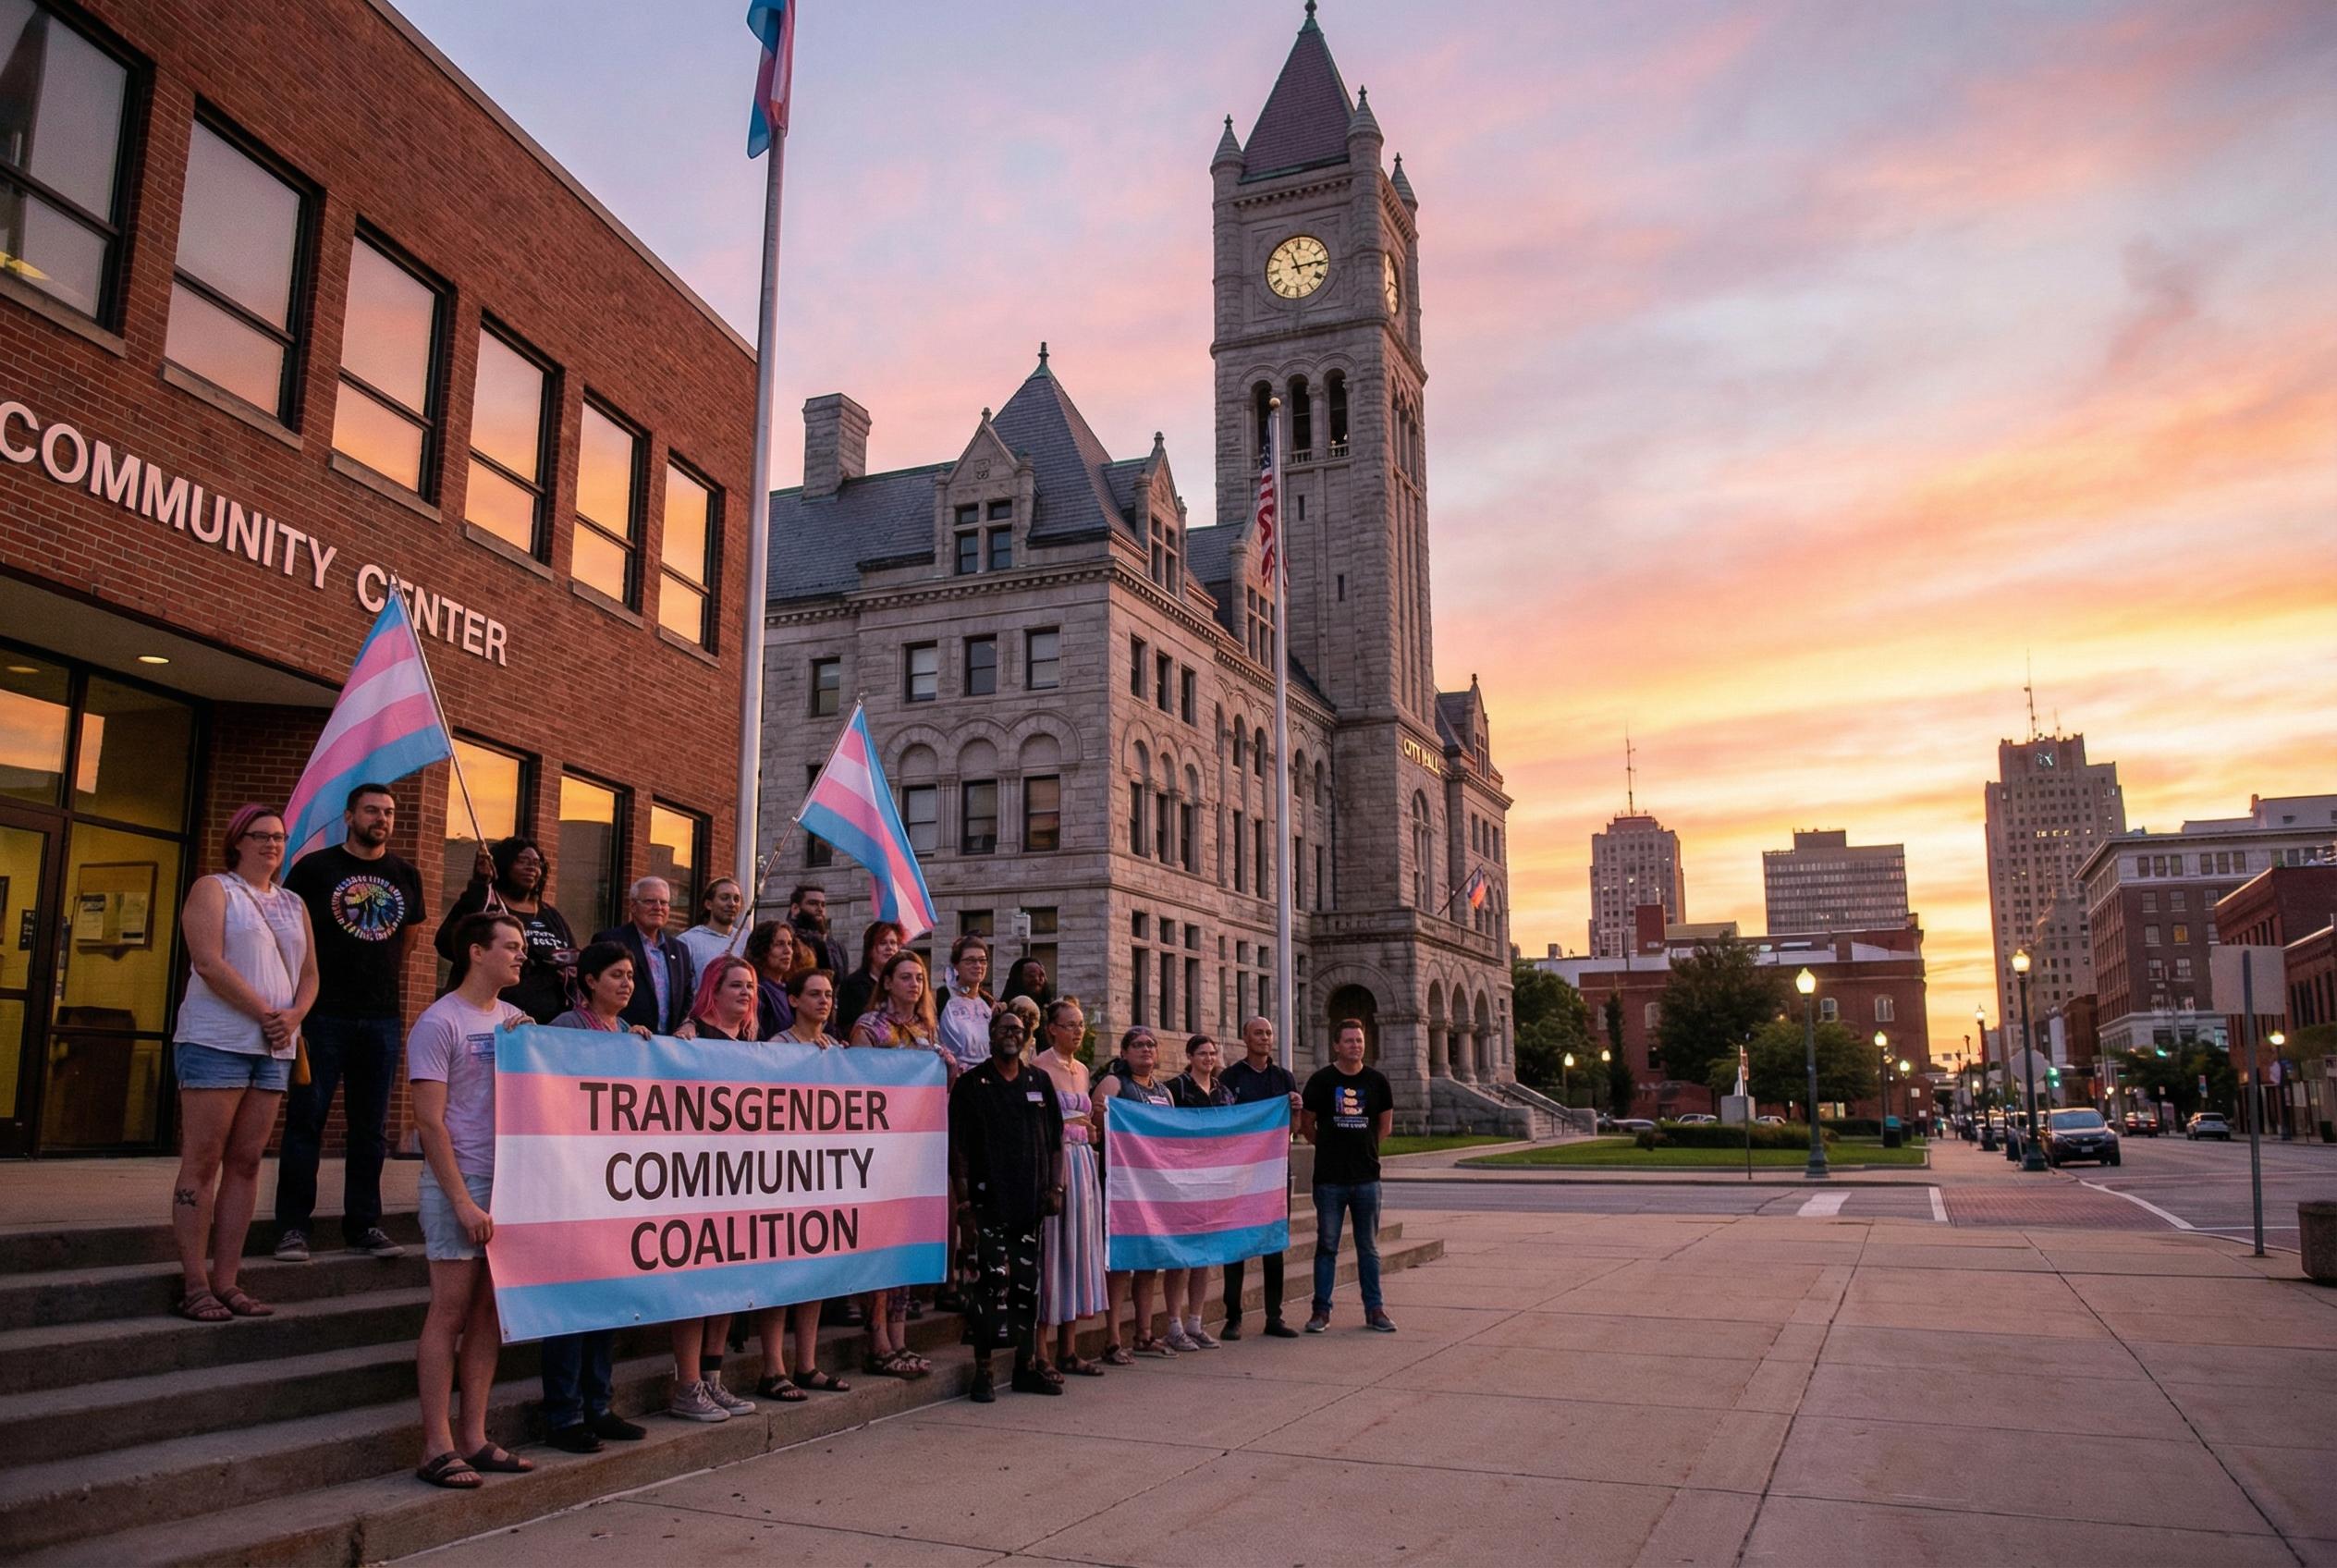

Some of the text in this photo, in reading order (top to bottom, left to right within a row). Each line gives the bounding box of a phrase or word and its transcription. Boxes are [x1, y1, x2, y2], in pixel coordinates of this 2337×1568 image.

[0, 401, 337, 589] COMMUNITY
[580, 1082, 889, 1132] TRANSGENDER
[606, 1147, 875, 1202] COMMUNITY
[630, 1207, 859, 1271] COALITION
